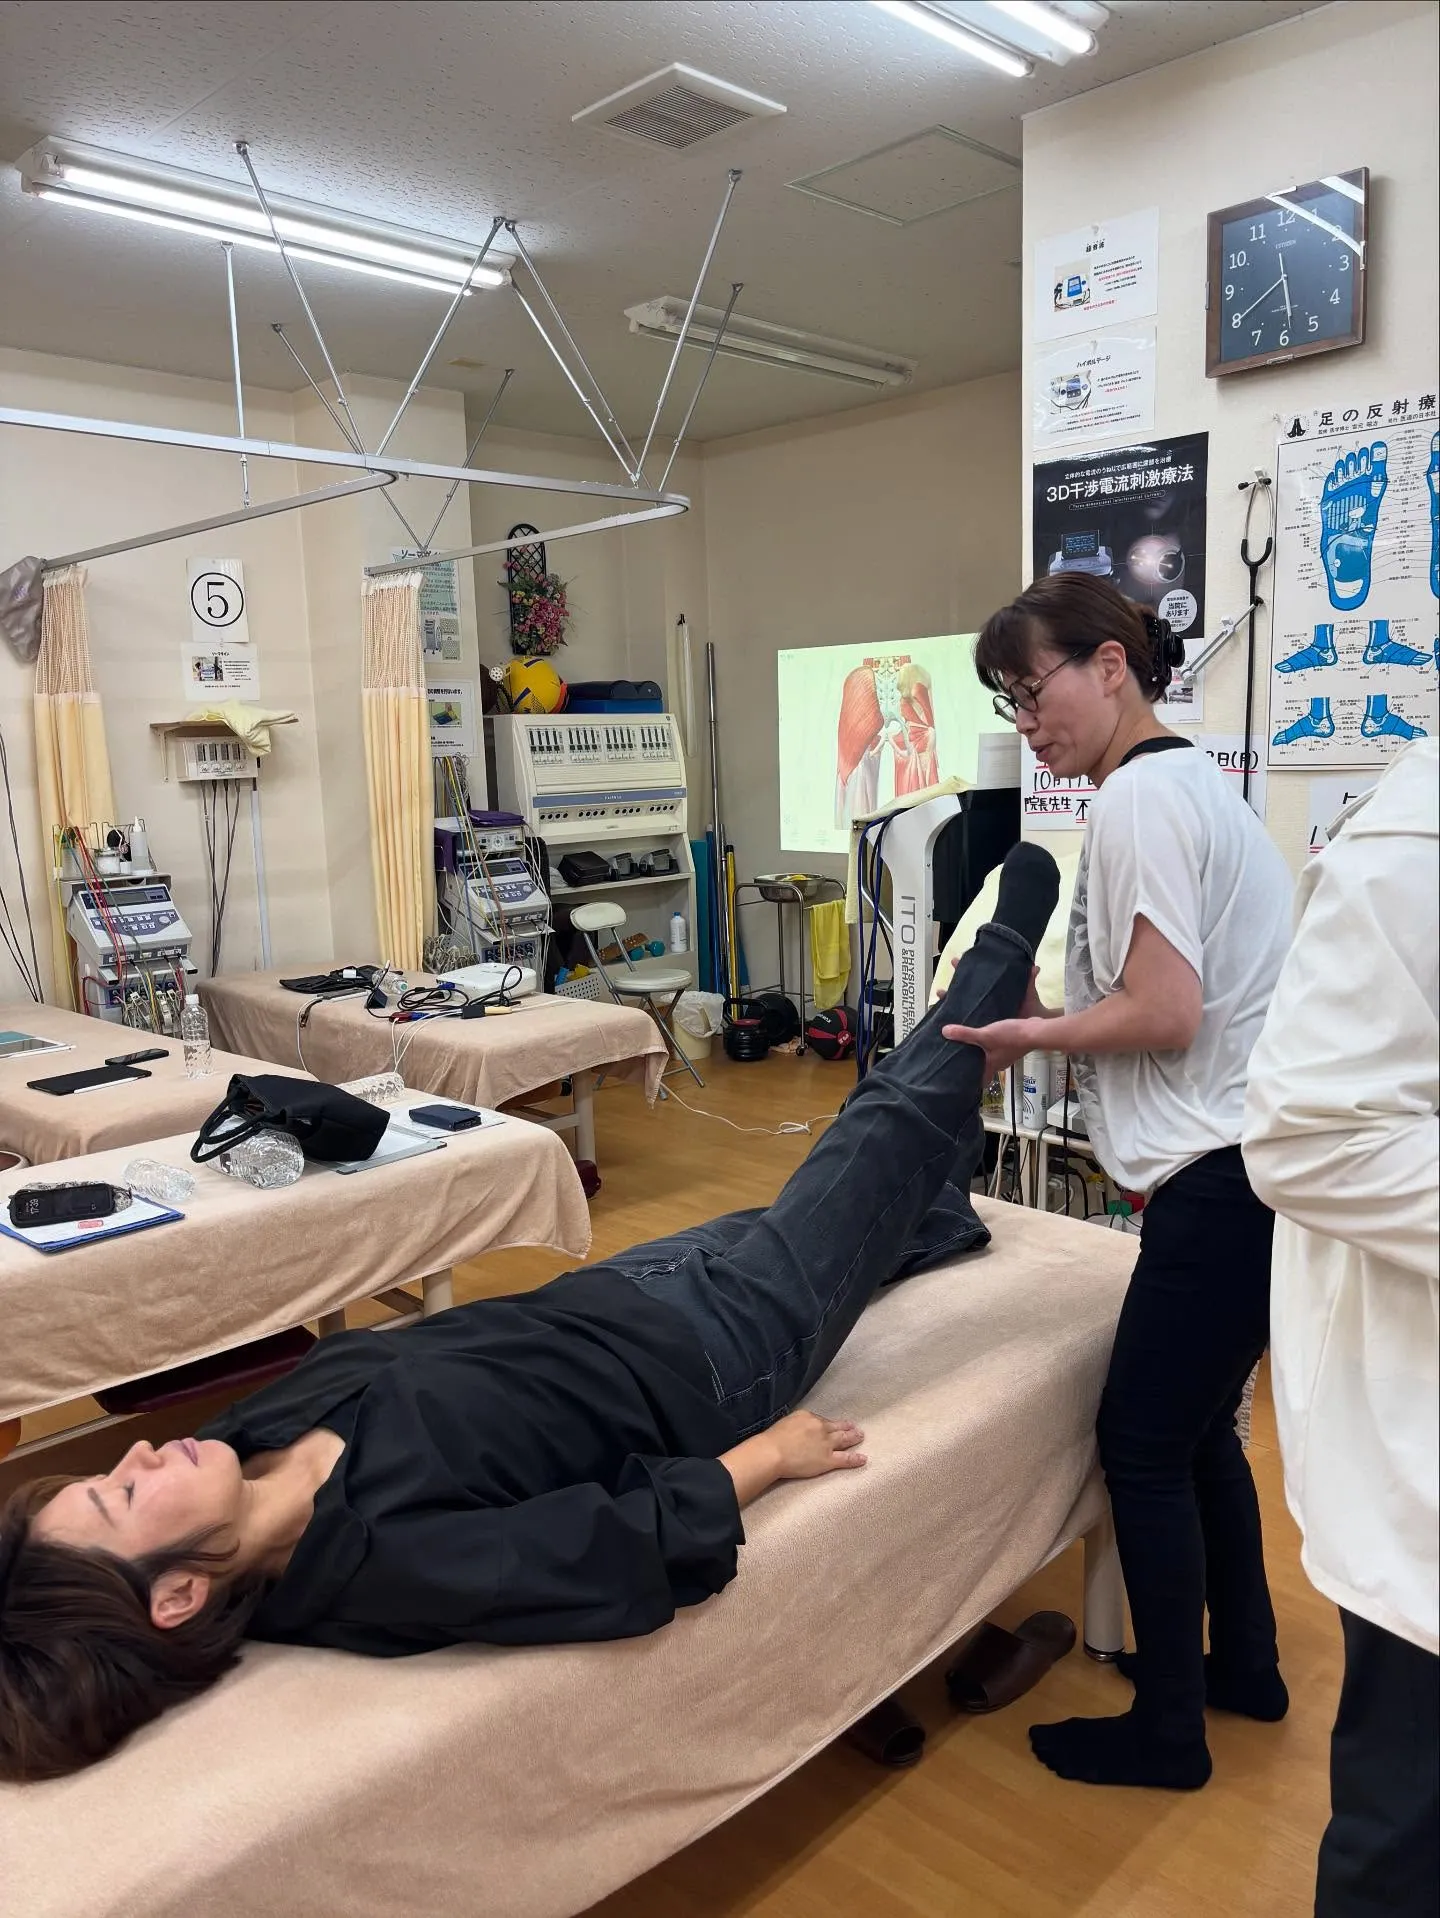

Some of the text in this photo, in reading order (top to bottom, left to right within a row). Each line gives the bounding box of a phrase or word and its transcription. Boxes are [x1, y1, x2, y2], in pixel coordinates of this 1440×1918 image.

[1277, 210, 1296, 227] 12
[1250, 224, 1266, 242] 11
[1229, 251, 1247, 269] 10
[1339, 255, 1350, 271] 3
[1225, 284, 1234, 300] 9
[1330, 288, 1340, 305] 4
[1232, 313, 1241, 328] 8
[1308, 315, 1319, 332] 5
[1252, 330, 1262, 346] 7
[1279, 330, 1289, 346] 6
[1046, 463, 1194, 503] 3D干渉電流刺激療法
[1024, 796, 1072, 812] 院長先生
[901, 896, 916, 944] ITO
[908, 949, 916, 1034] PHYSIOTHERA
